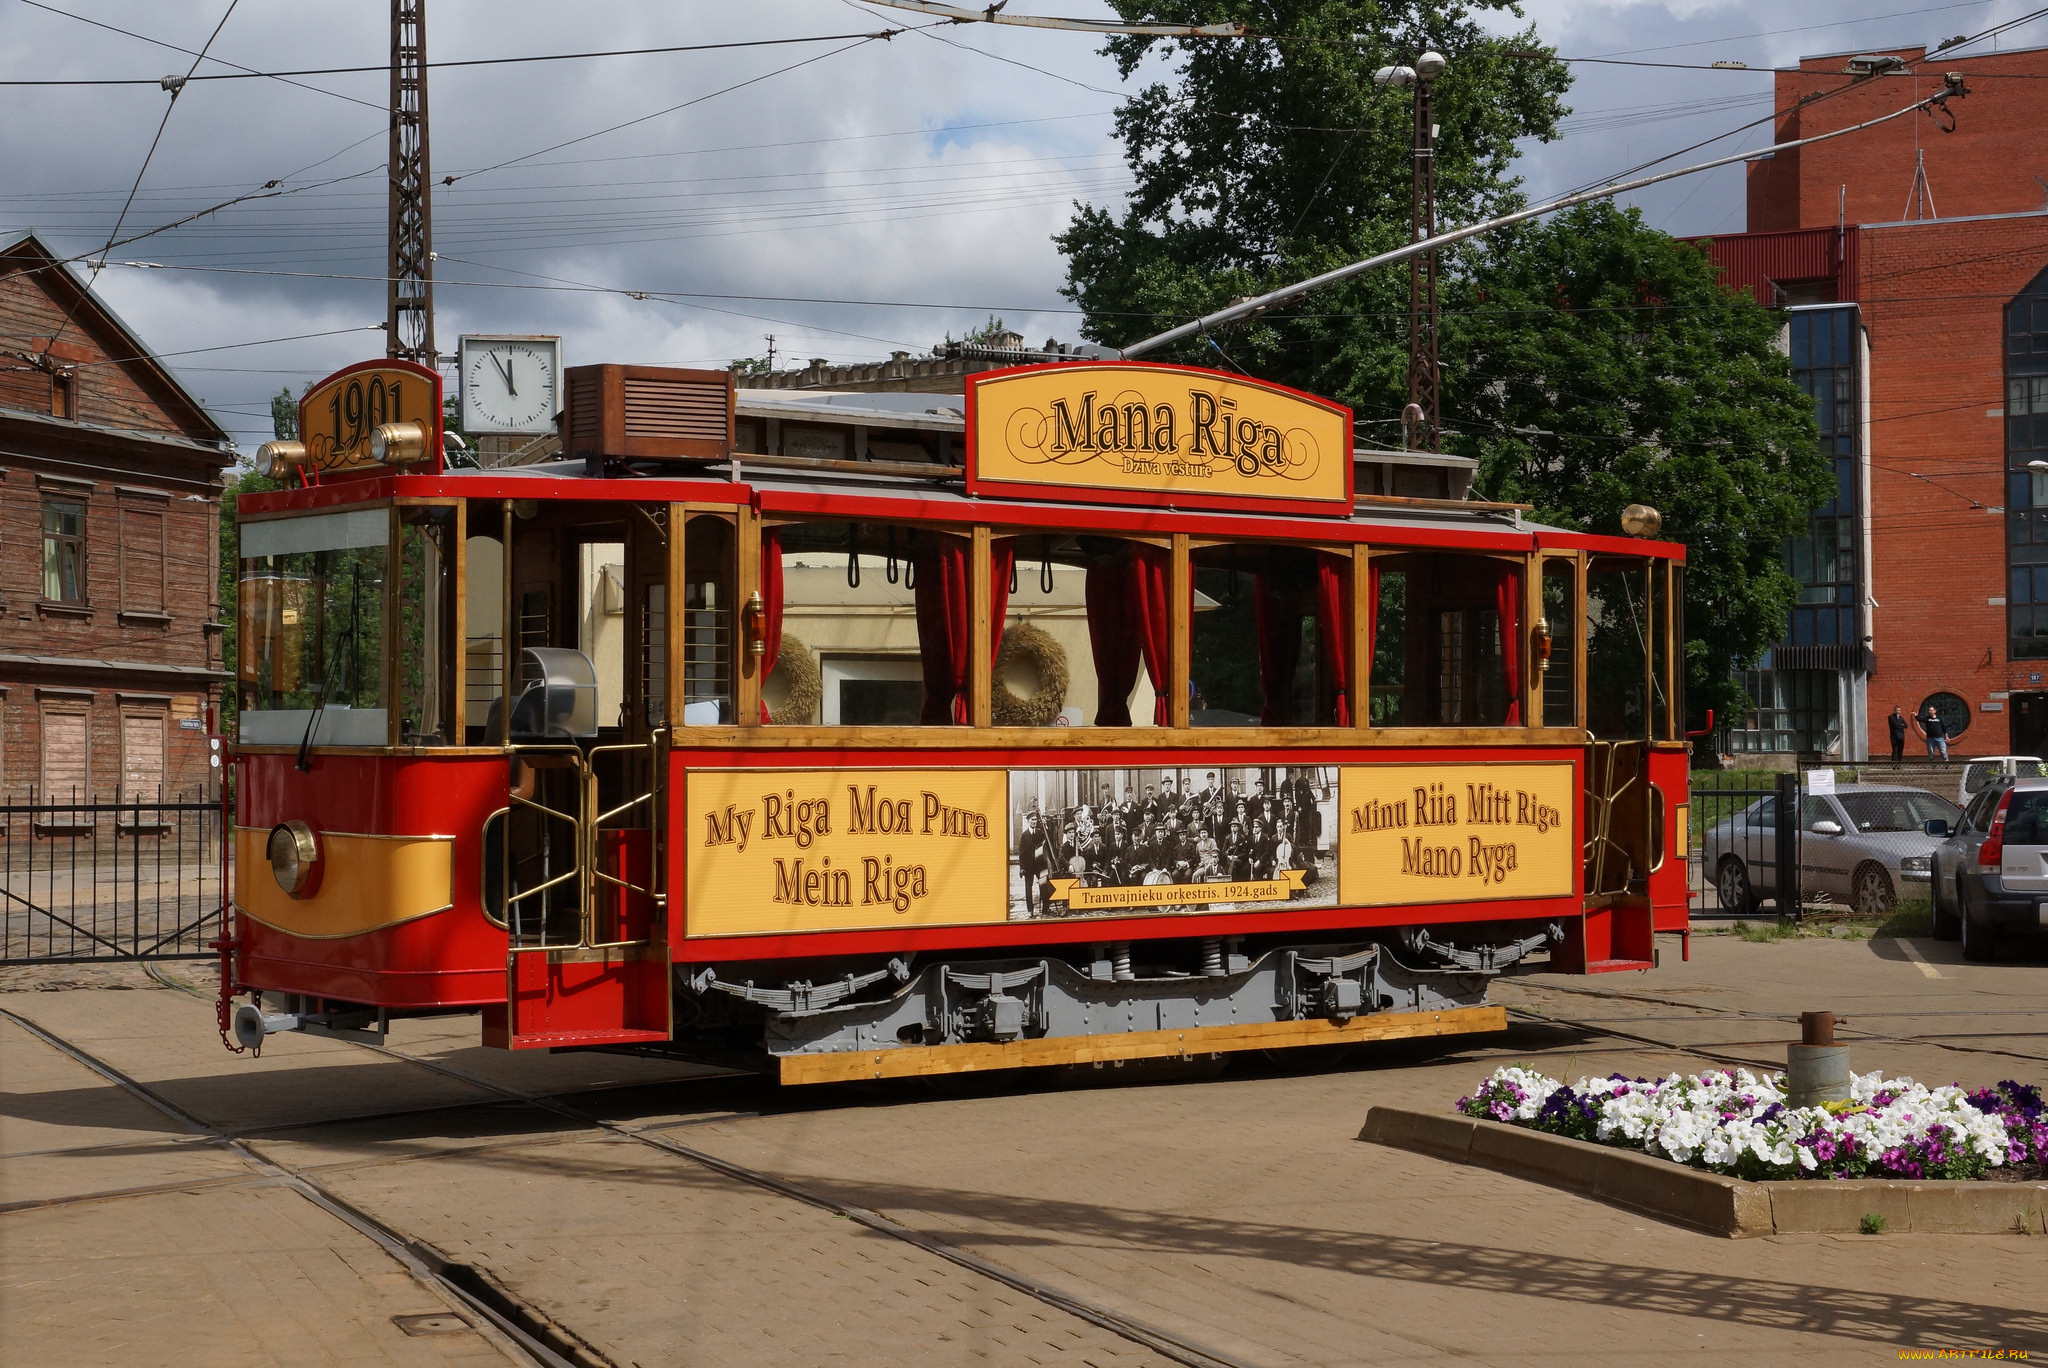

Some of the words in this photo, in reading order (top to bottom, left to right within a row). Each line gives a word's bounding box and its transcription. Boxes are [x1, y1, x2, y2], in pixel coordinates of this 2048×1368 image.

[329, 374, 402, 456] 1901
[1050, 389, 1179, 453] Mana
[1188, 388, 1286, 477] Rīga
[1122, 457, 1161, 474] Dzīva
[1163, 460, 1213, 478] vēsture
[705, 804, 755, 853] My
[761, 788, 833, 850] Riga
[847, 784, 913, 834] Моя
[920, 790, 990, 840] Рига
[1351, 797, 1408, 834] Minu
[1413, 782, 1458, 827] Riia
[1466, 782, 1511, 825] Mitt
[1516, 789, 1561, 834] Riga
[773, 856, 853, 907] Mein
[861, 854, 929, 914] Riga
[1401, 836, 1462, 878] Mano
[1467, 835, 1518, 886] Ryga
[1082, 889, 1163, 904] Tramvajnieku
[1166, 887, 1220, 903] orķestris.
[1224, 884, 1278, 899] 1924.gads
